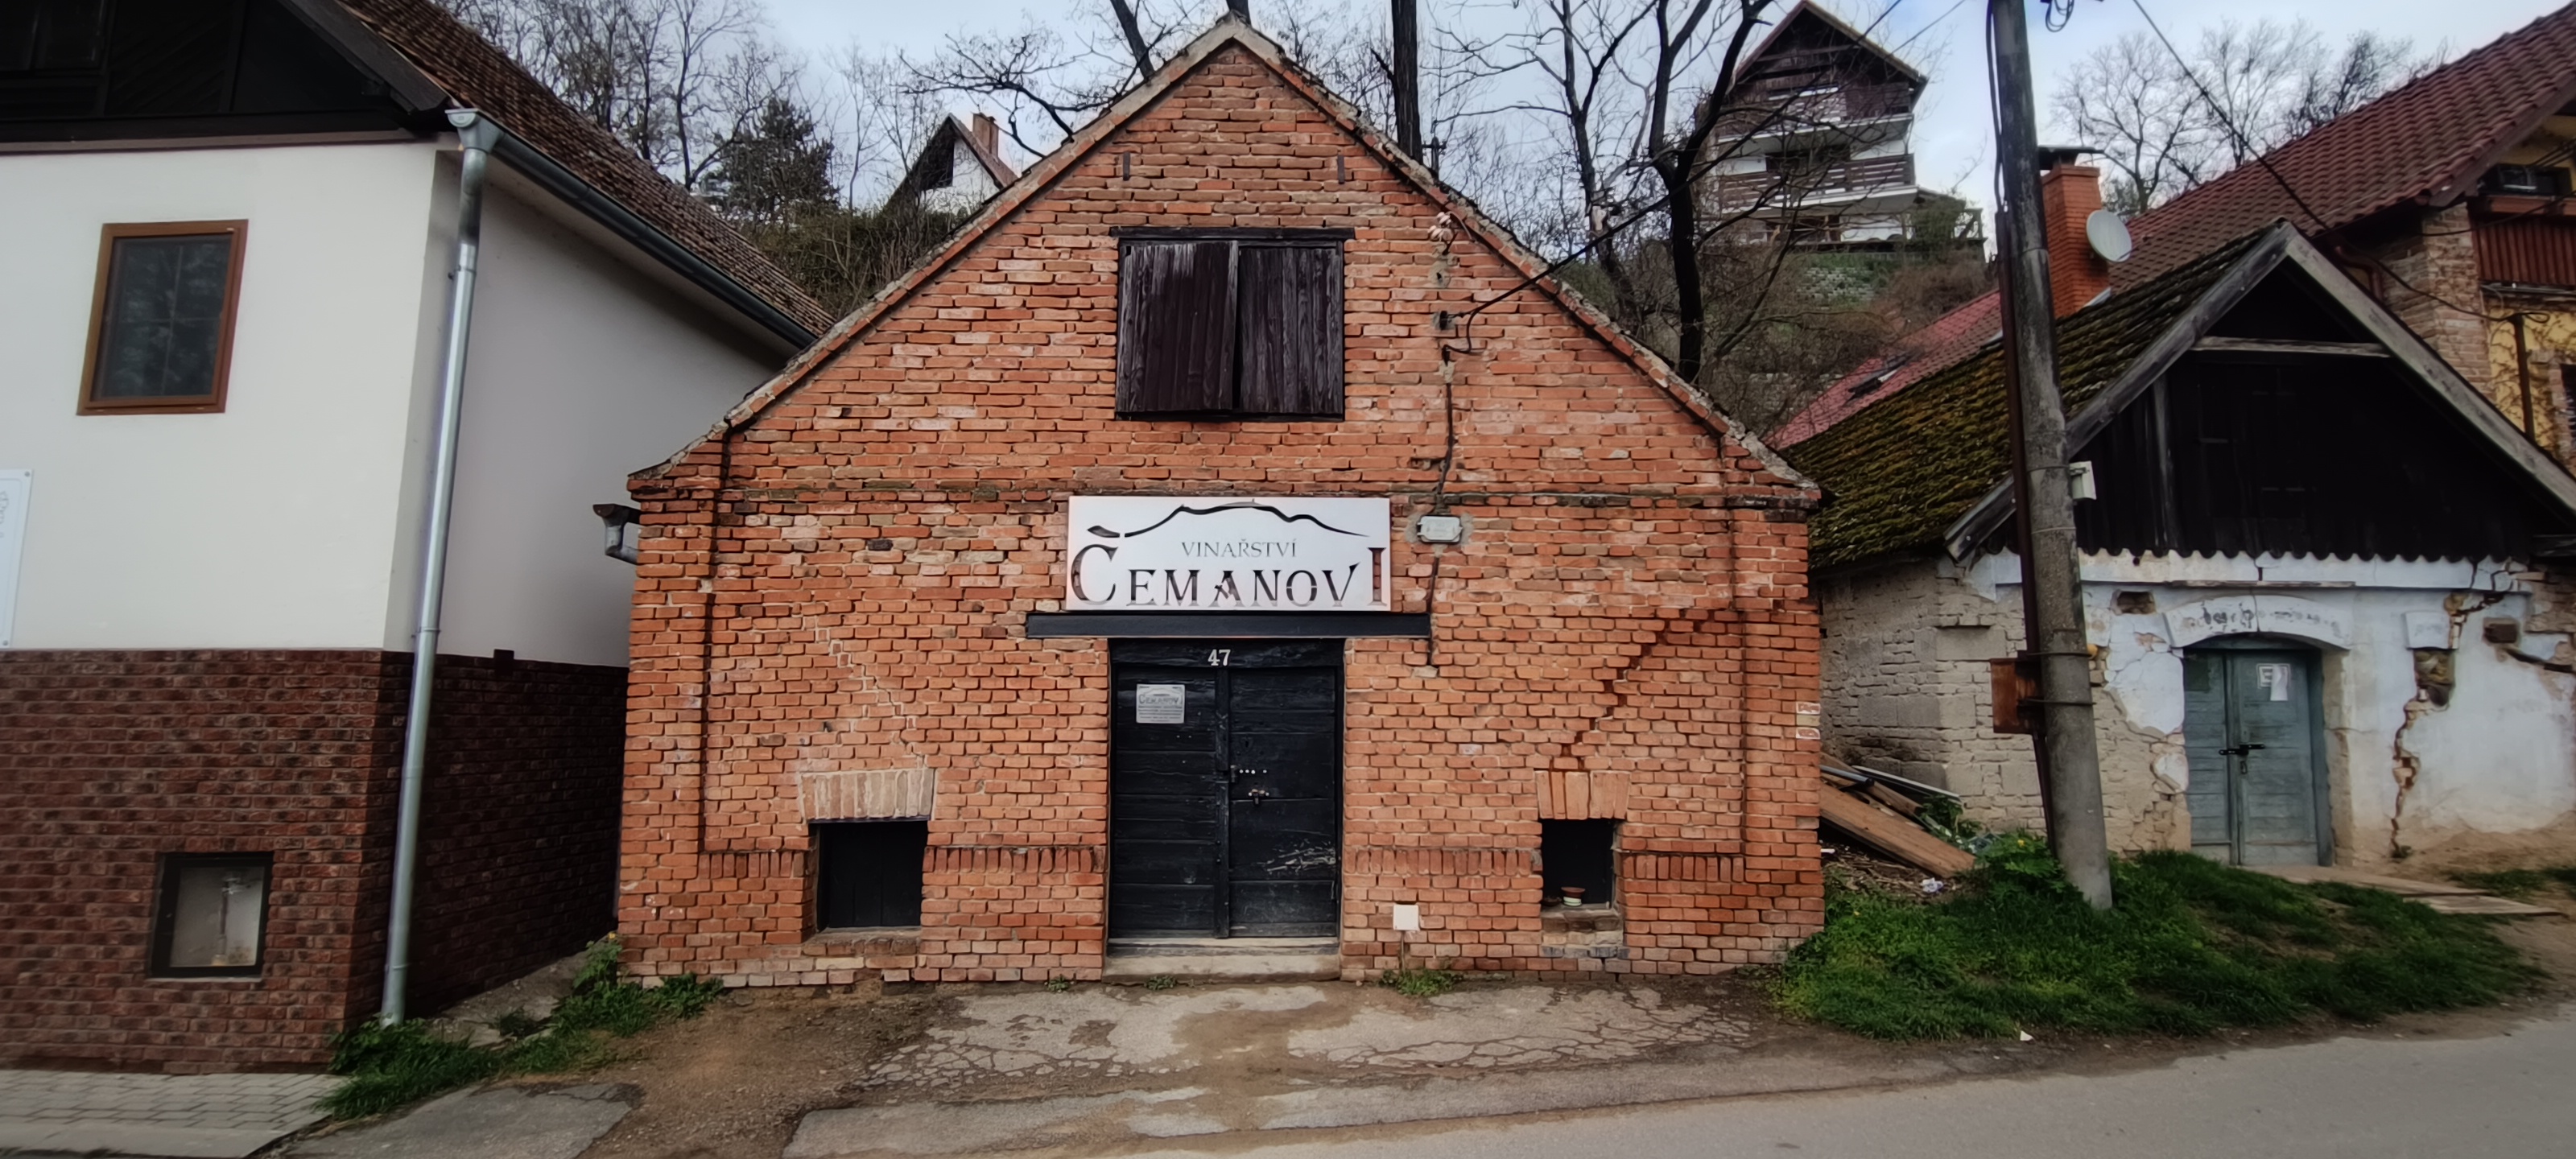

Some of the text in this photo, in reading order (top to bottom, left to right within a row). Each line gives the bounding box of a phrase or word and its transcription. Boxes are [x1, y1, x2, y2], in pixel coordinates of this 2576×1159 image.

[1181, 538, 1297, 559] VINAŘSTVÍ
[1071, 525, 1387, 607] ČEMANOVI
[1208, 649, 1231, 666] 47
